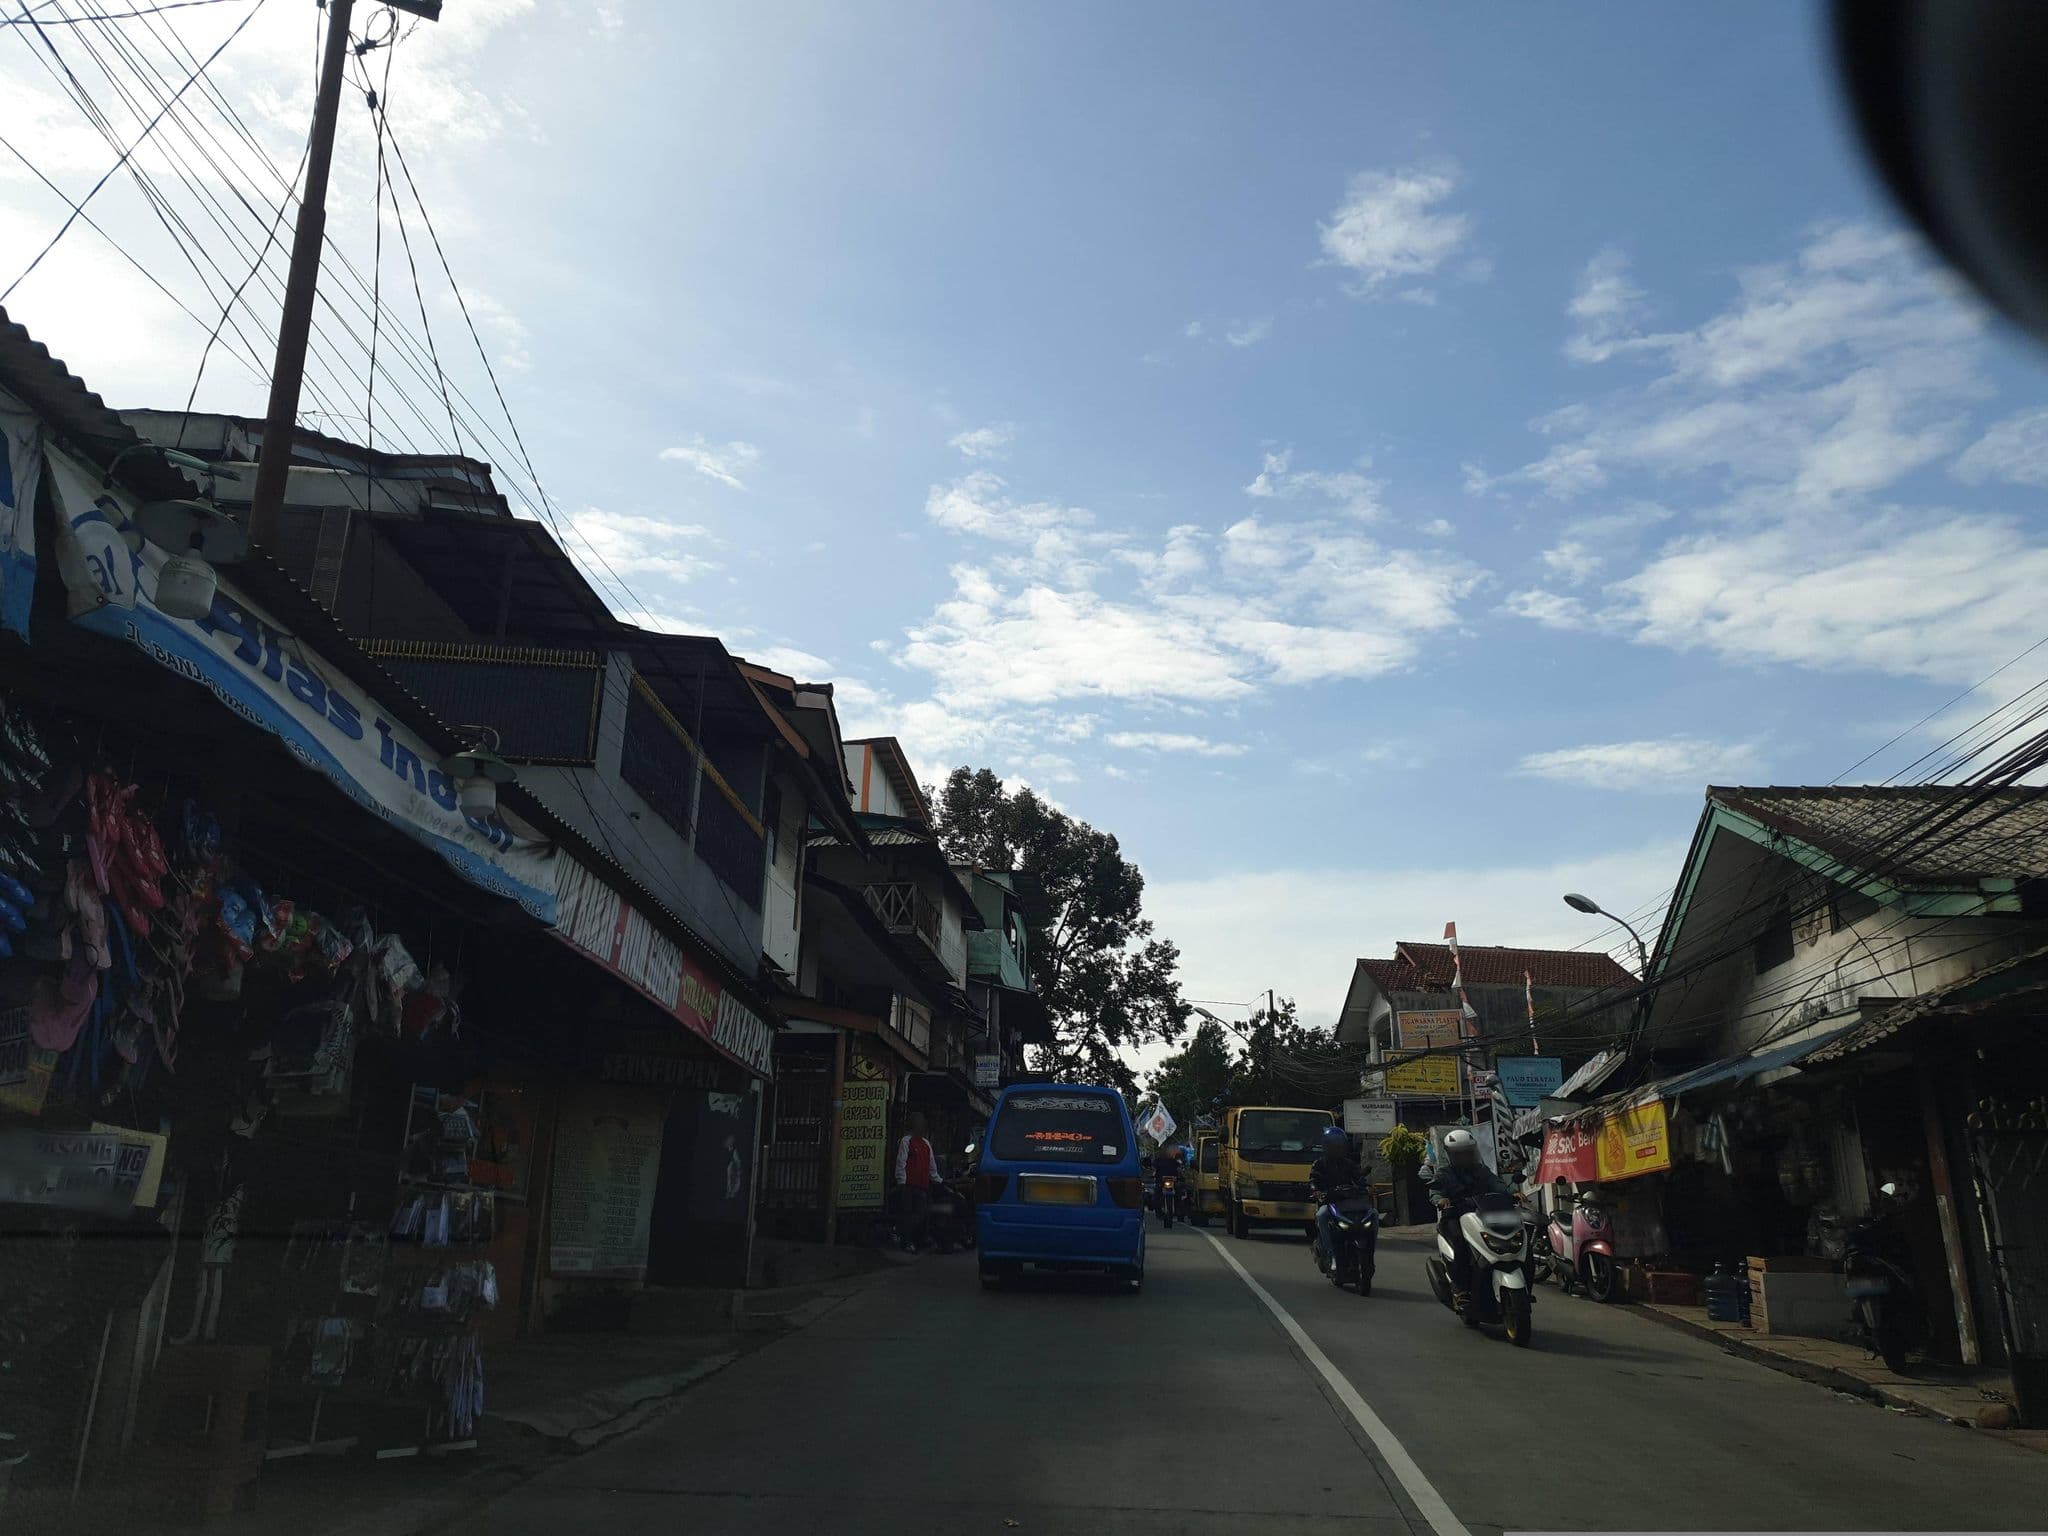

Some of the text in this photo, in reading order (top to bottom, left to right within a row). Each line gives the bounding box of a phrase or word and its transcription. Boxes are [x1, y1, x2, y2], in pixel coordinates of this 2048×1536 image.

[842, 1087, 885, 1101] BUBUR
[843, 1106, 881, 1121] AYAM
[840, 1125, 884, 1140] CAKWE
[846, 1145, 876, 1161] APIN
